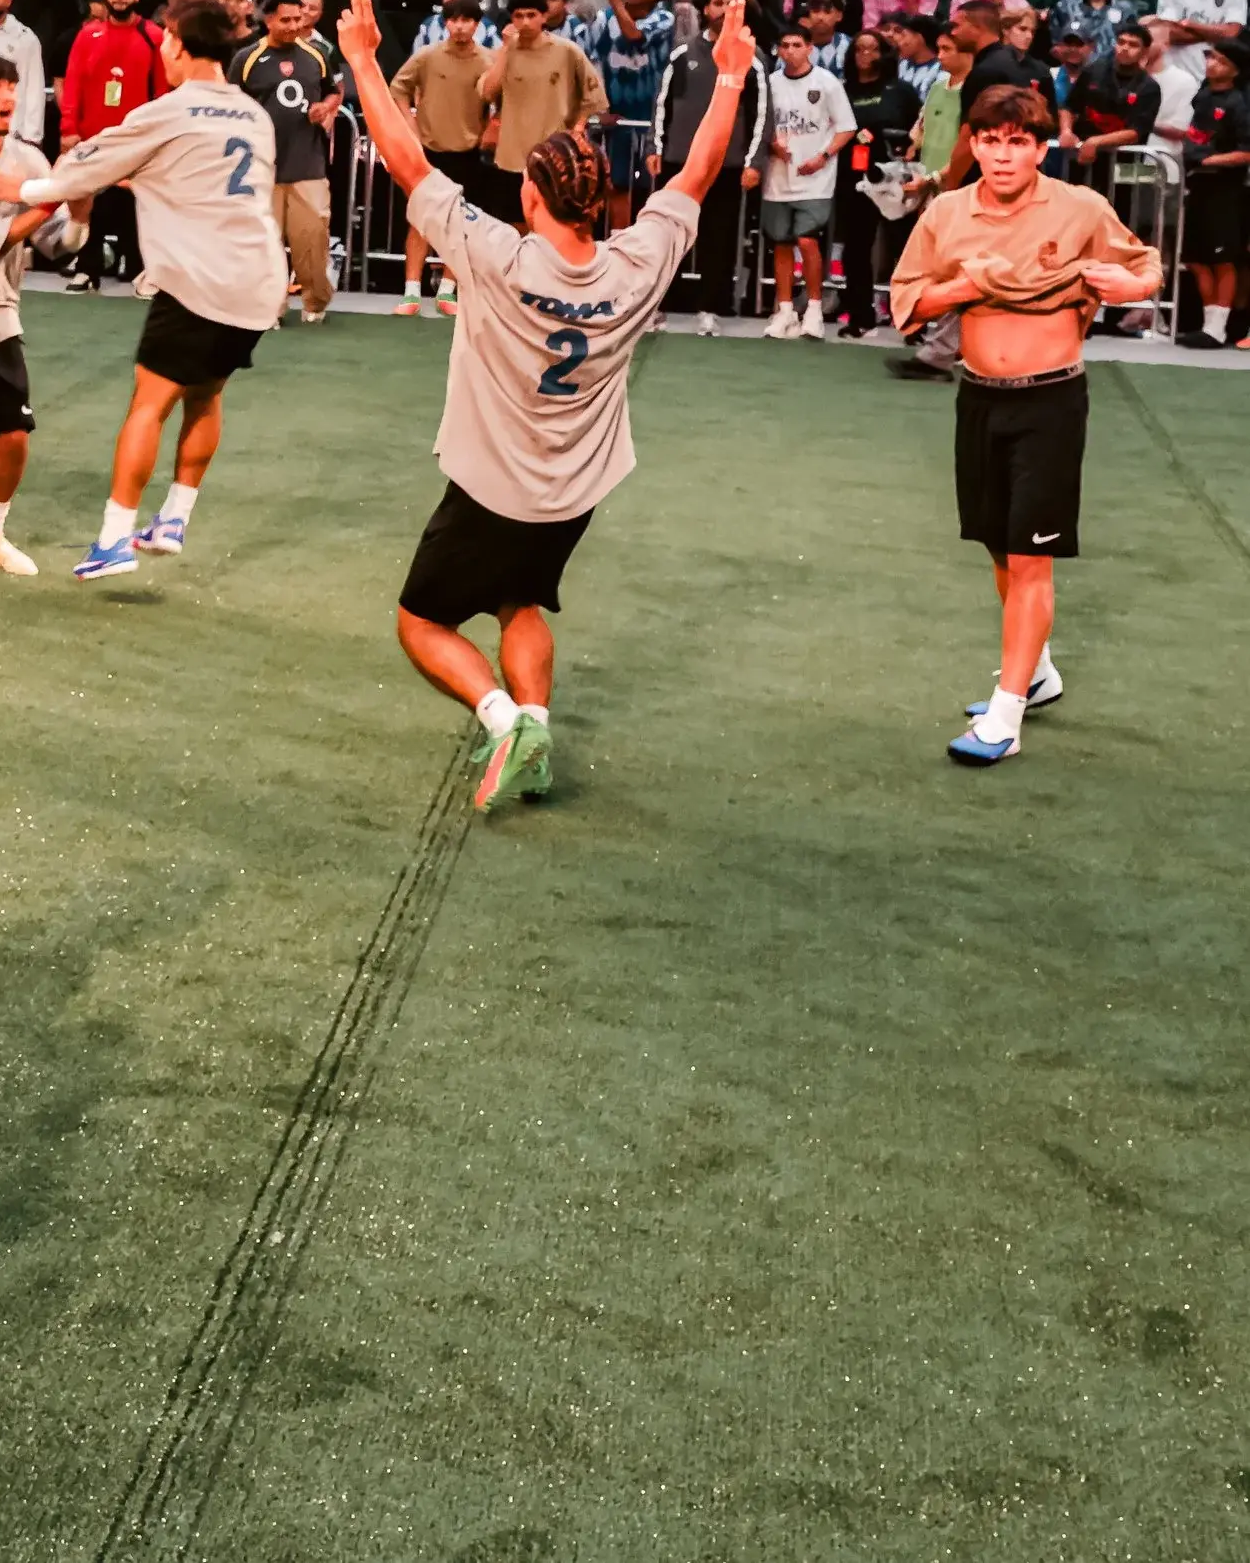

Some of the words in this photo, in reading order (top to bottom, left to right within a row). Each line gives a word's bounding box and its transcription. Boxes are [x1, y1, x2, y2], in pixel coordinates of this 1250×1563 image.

[223, 136, 255, 196] 2
[519, 290, 616, 320] TOMA
[537, 328, 589, 396] 2
